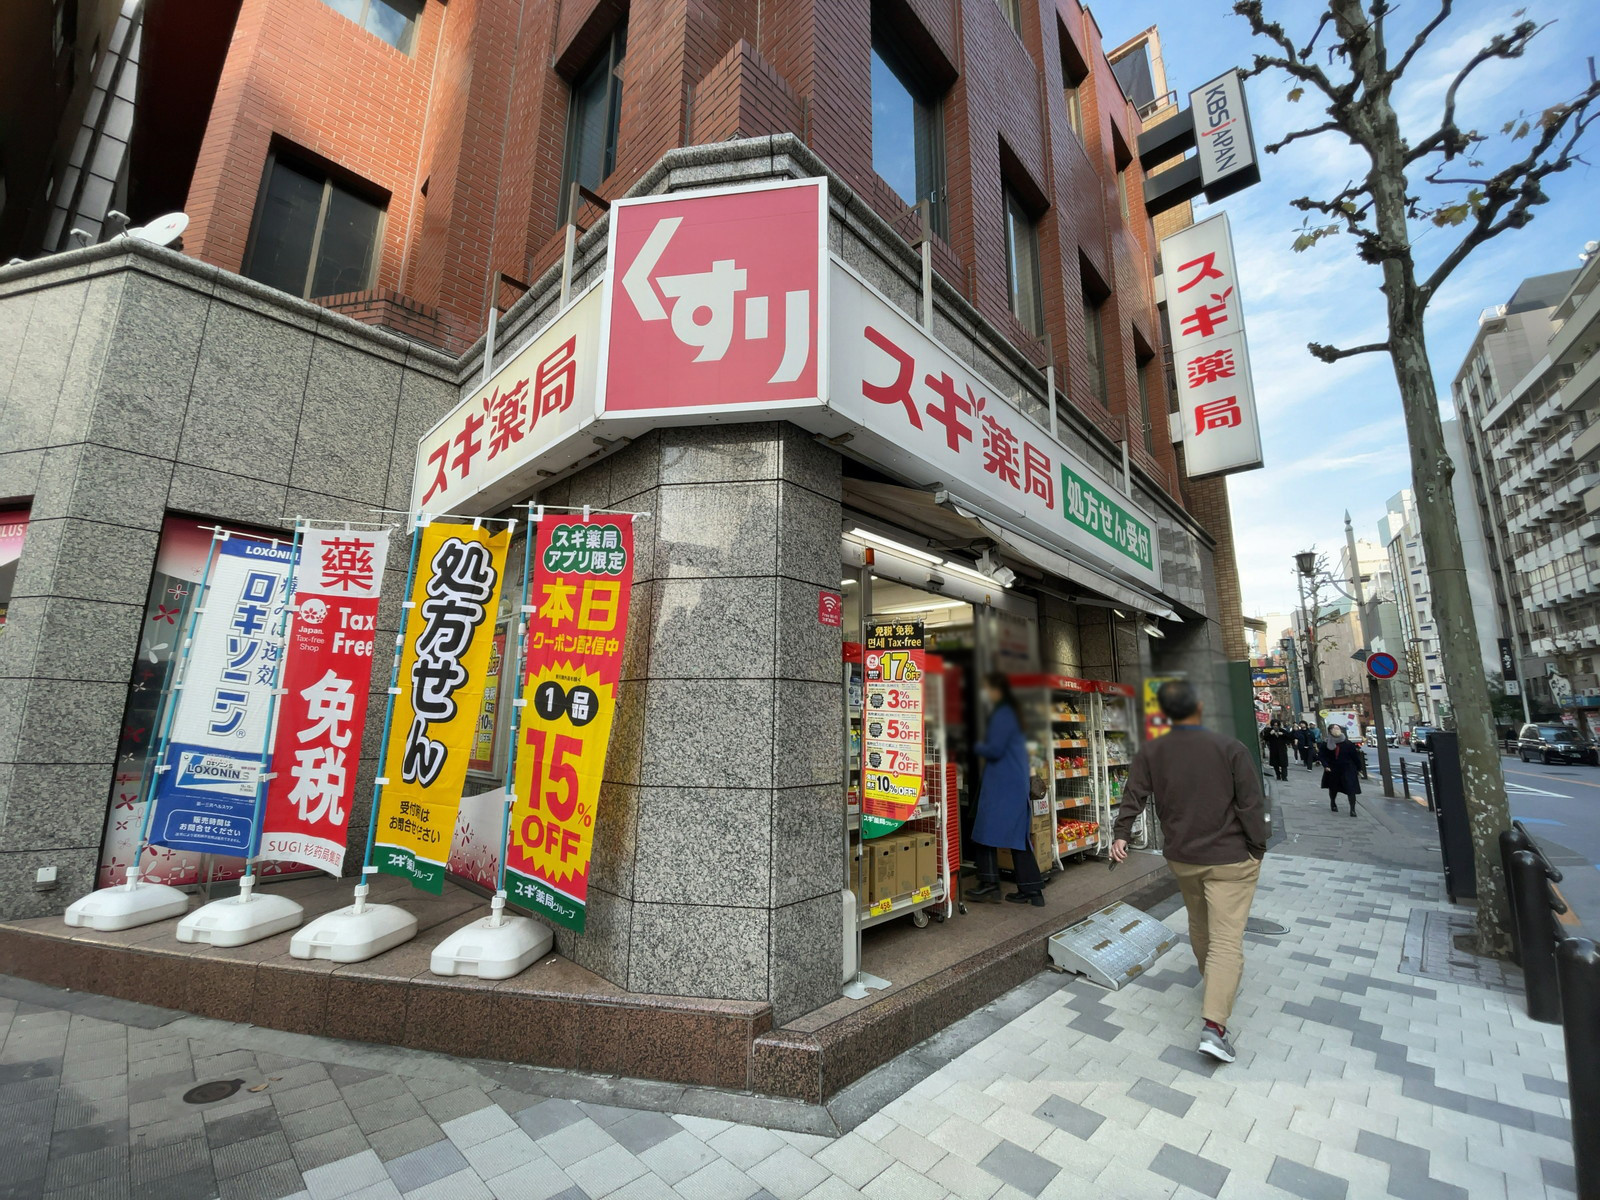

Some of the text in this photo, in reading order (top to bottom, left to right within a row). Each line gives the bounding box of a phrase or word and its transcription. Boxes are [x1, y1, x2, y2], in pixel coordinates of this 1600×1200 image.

[622, 216, 810, 384] くすり
[1177, 251, 1243, 437] スギ薬局
[422, 334, 577, 507] スギ薬局
[862, 325, 1055, 510] スギ薬局
[1066, 475, 1149, 564] 処方せん受付
[0, 524, 23, 538] LUS
[555, 529, 618, 550] スギ薬局
[320, 537, 374, 591] 藥
[548, 550, 624, 571] アプリ限定
[539, 577, 621, 632] 本日
[339, 607, 375, 631] Tax
[296, 634, 325, 645] Tax-free
[299, 643, 320, 653] Shop
[332, 632, 373, 656] Free
[533, 631, 619, 657] クーポン配信中
[868, 637, 922, 648] 면세 Tax-free
[402, 537, 496, 789] 処方せん
[905, 671, 921, 681] OFF
[899, 700, 920, 709] OFF
[899, 730, 920, 740] OFF
[288, 668, 355, 825] 免税
[187, 764, 240, 779] LOXONIN
[898, 762, 919, 772] OFF
[179, 823, 241, 837] お問合せください
[193, 816, 231, 827] 販売時間は
[268, 840, 302, 853] SUGI
[521, 814, 581, 863] OFF
[515, 881, 576, 919] スギ薬局グループ
